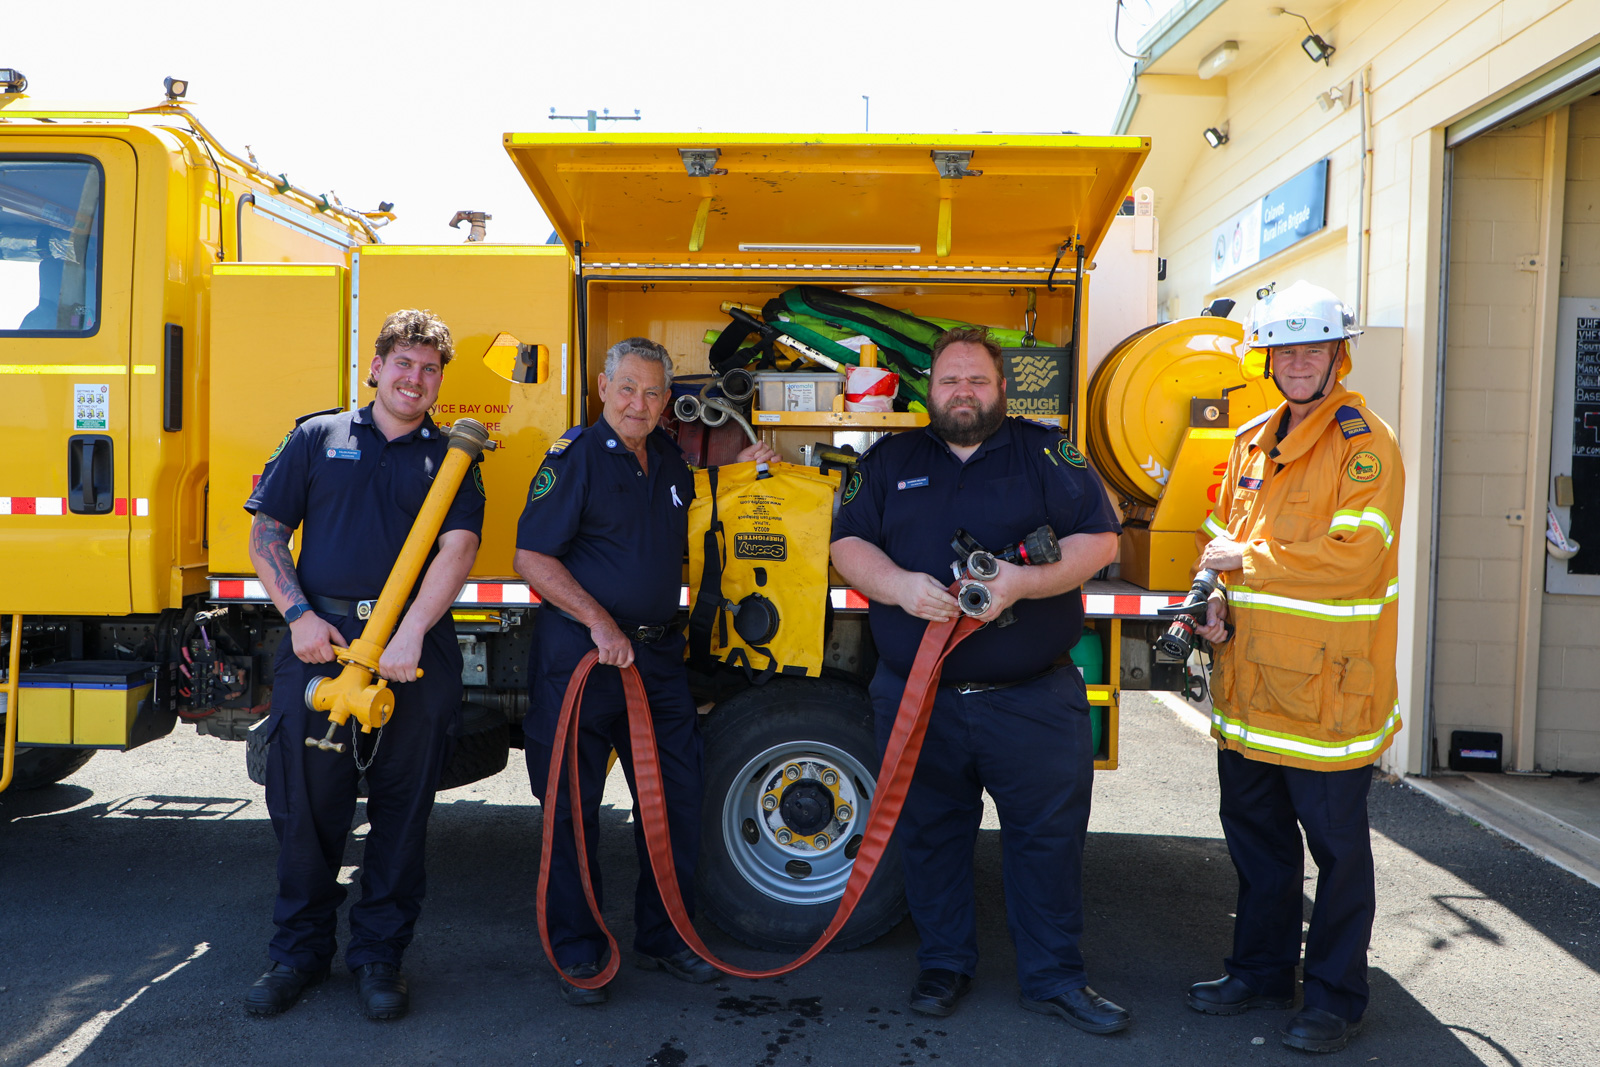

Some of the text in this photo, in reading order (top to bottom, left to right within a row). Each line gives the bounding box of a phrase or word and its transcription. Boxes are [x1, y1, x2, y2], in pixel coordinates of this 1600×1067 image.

[1264, 202, 1285, 223] Calavos
[1263, 222, 1278, 242] Rural
[1278, 219, 1287, 236] Fire
[1288, 205, 1310, 229] Brigade
[1579, 319, 1599, 328] UHF
[430, 404, 514, 414] VICE BAY ONLY
[1006, 398, 1060, 410] ROUGH
[739, 542, 784, 557] Scotty
